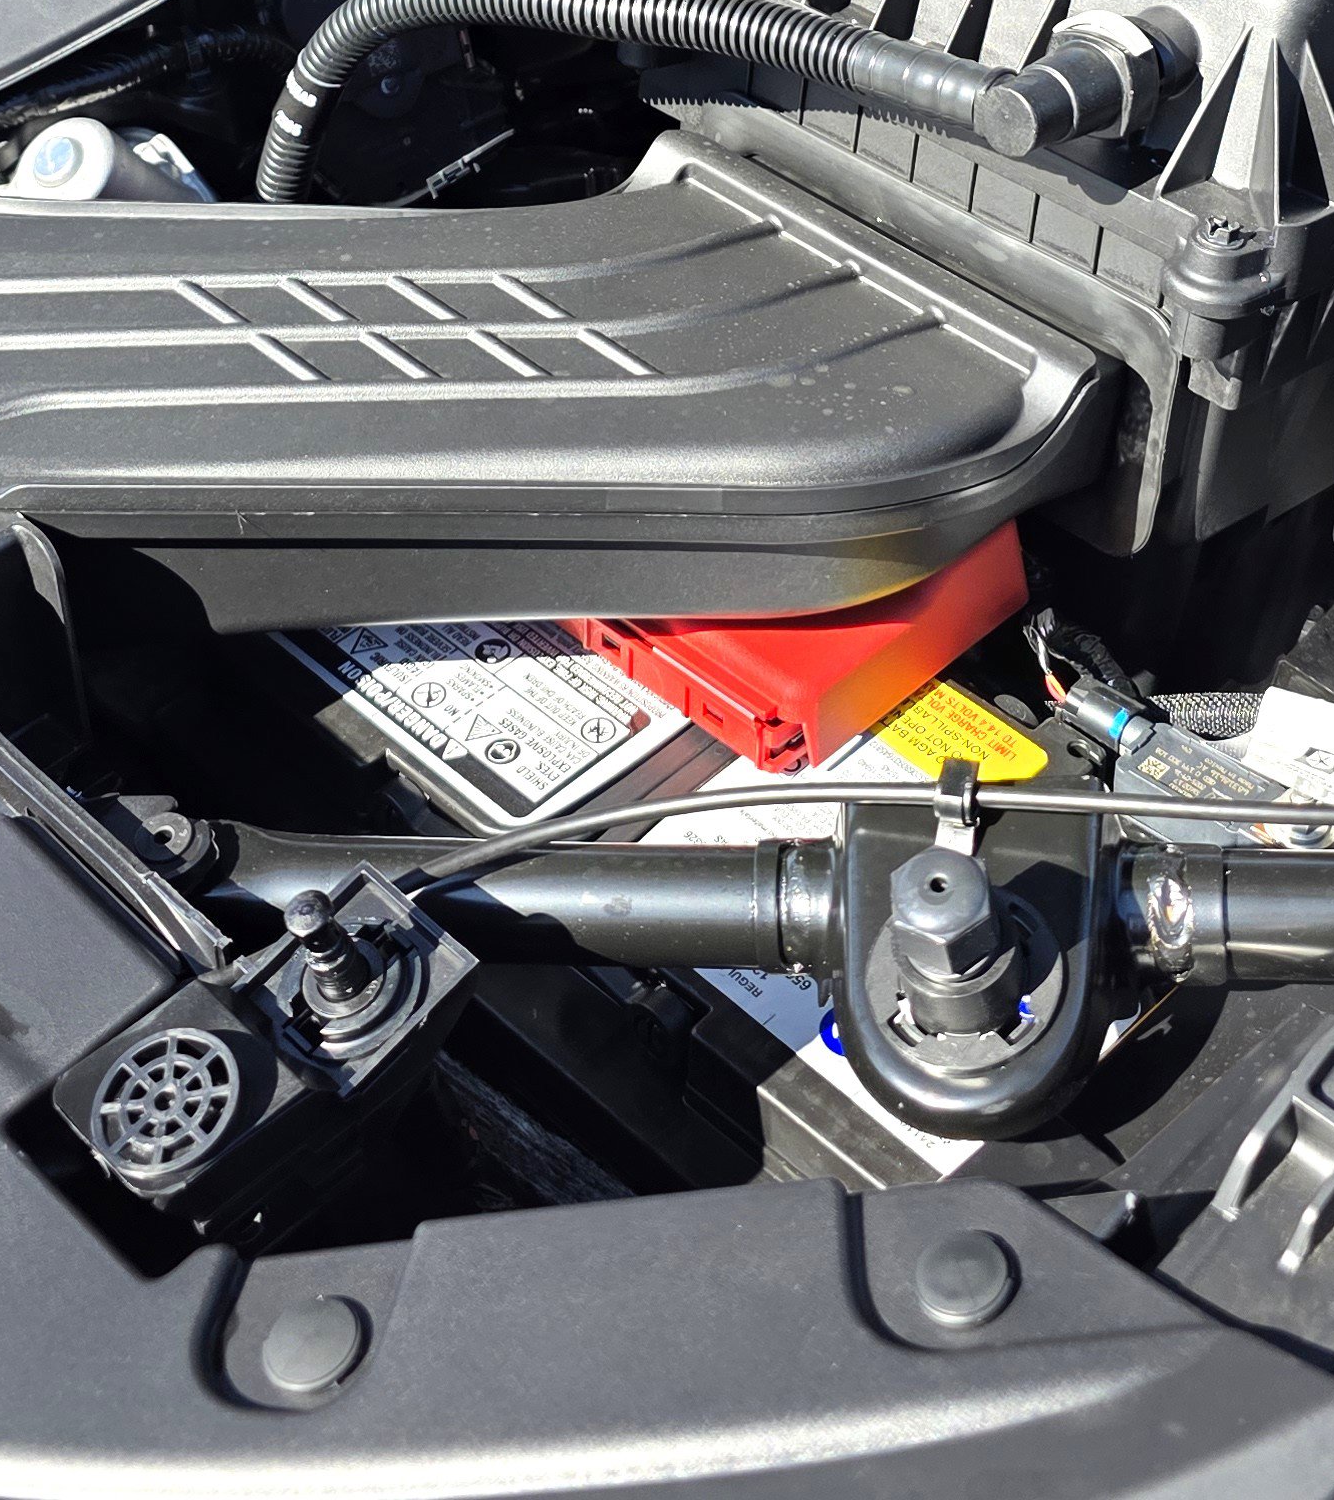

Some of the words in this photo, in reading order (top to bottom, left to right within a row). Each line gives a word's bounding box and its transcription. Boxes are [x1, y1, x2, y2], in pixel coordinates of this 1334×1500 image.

[367, 651, 410, 682] SULFURIC
[330, 659, 452, 750] DANGER/POISON
[442, 703, 460, 716] NO
[944, 695, 980, 722] VOLTS
[497, 717, 528, 739] GASES
[944, 709, 988, 741] CHARGE
[977, 718, 1002, 736] 14.4
[924, 732, 951, 752] NOT
[985, 737, 1017, 761] LIMIT
[1000, 733, 1019, 747] TO
[523, 736, 572, 772] EXPLOSIVE
[513, 764, 550, 790] SHIELD
